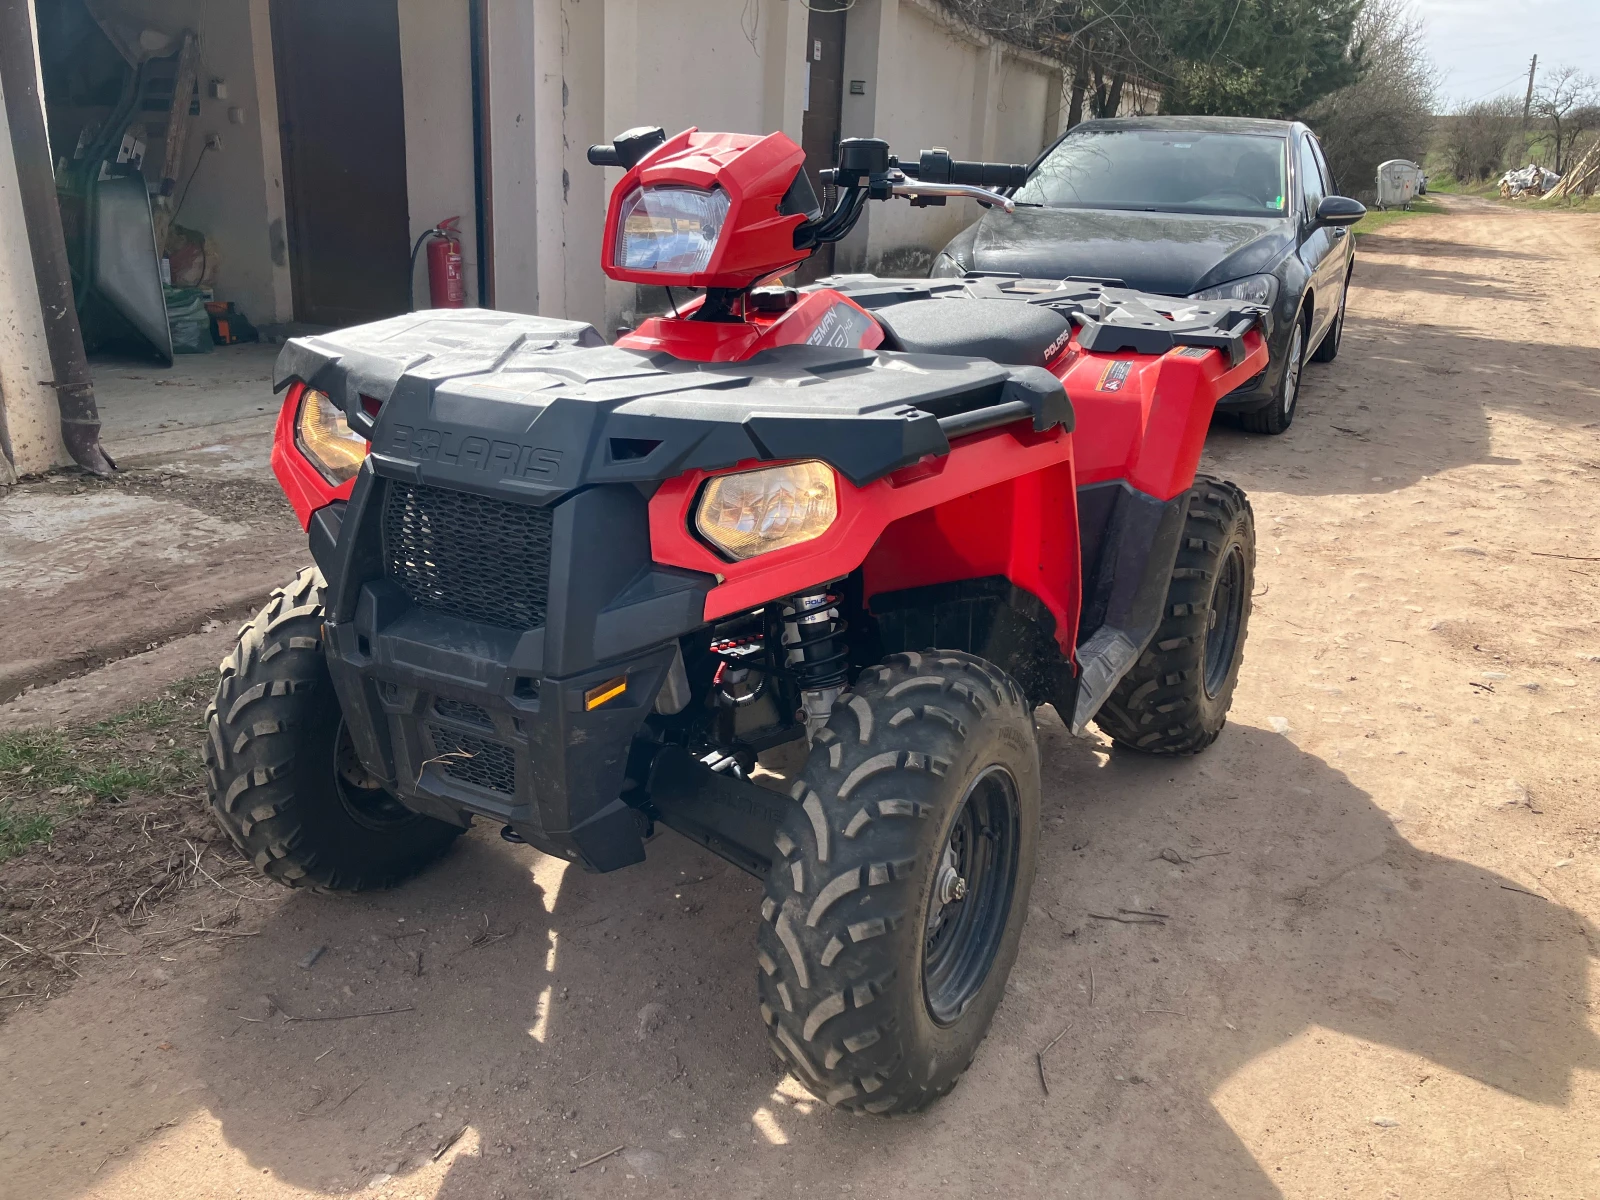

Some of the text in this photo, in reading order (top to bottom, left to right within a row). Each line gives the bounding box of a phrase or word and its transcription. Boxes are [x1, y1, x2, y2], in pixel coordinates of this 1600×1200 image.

[805, 306, 838, 346] TSMAN
[1043, 328, 1069, 360] POLARIS
[387, 423, 564, 482] POLARIS
